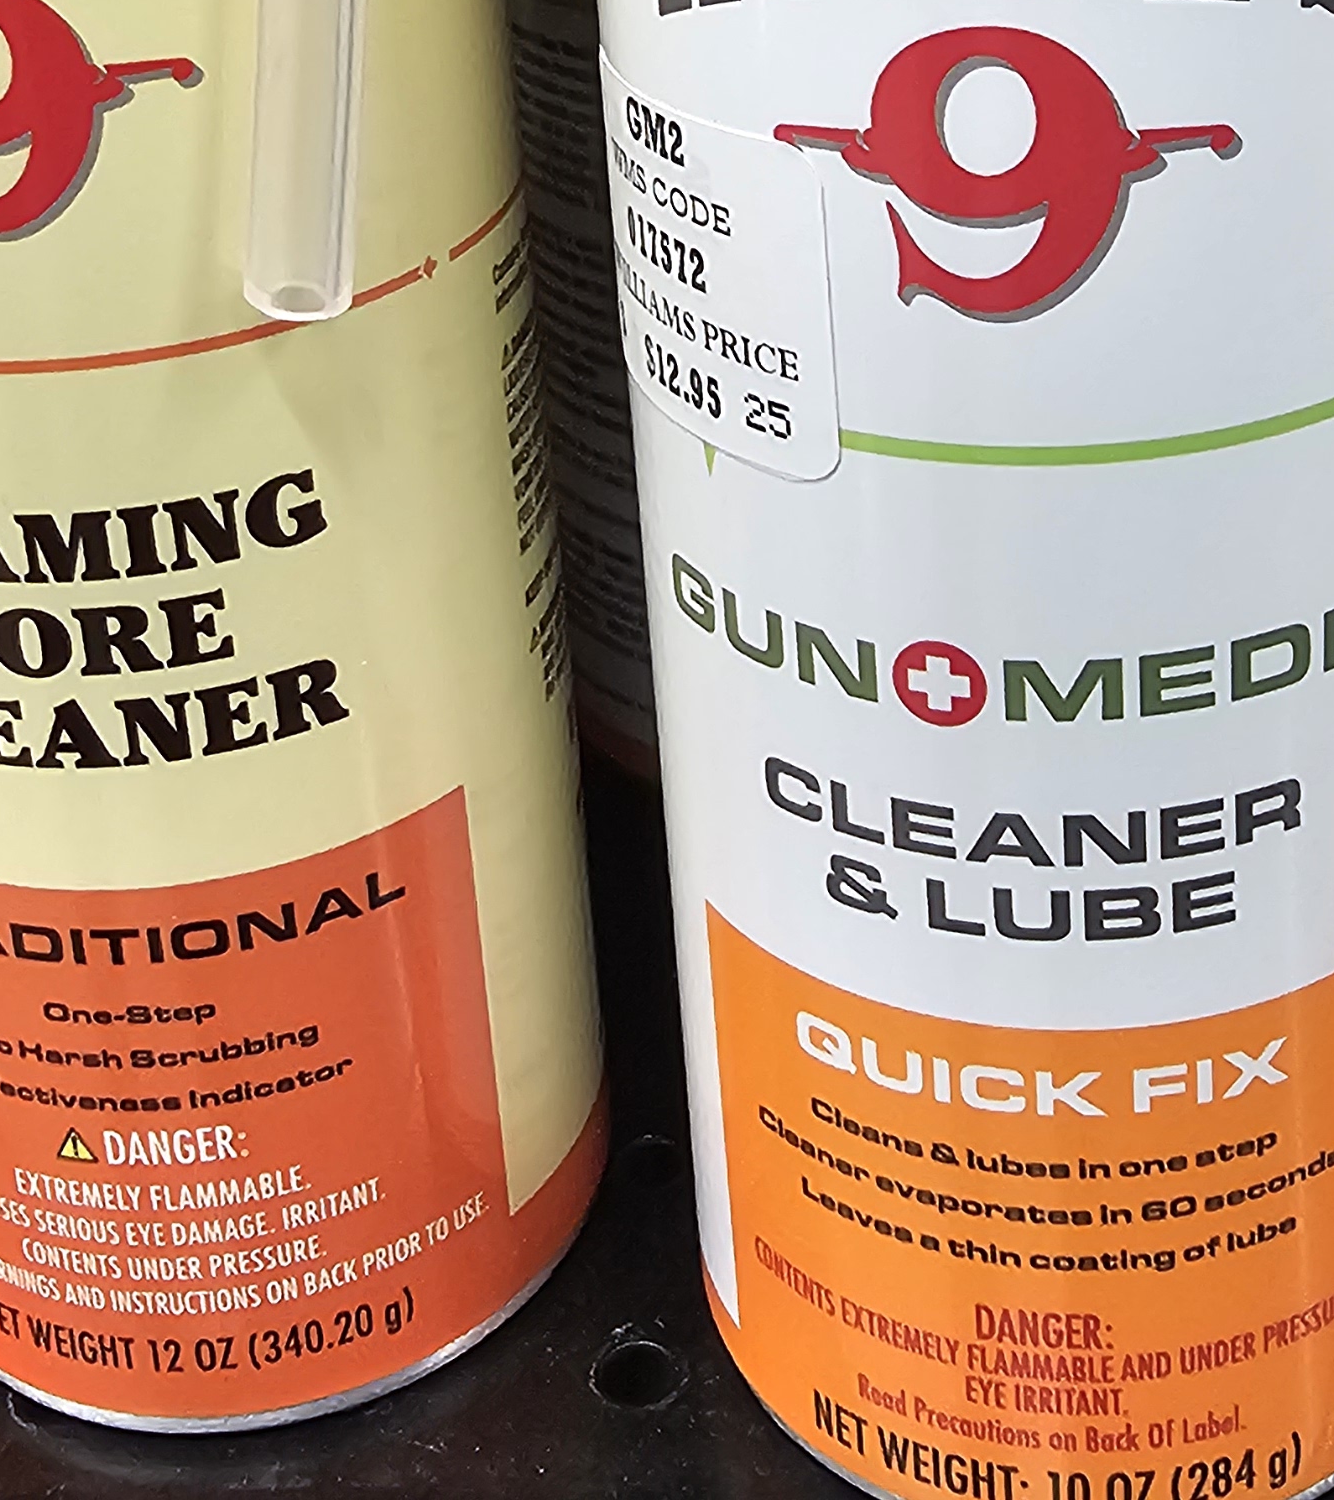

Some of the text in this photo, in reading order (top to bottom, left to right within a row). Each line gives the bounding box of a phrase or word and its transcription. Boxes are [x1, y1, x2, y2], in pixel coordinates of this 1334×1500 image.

[626, 96, 685, 168] GM2
[652, 176, 732, 237] CODE
[627, 206, 708, 294] 017572
[702, 318, 800, 382] PRICE
[644, 333, 791, 440] $12.95 25
[764, 756, 1303, 868] CLEANER
[825, 854, 1238, 942] & LUBE
[18, 1040, 123, 1070] Harsh
[130, 1025, 319, 1069] Scrubbing
[43, 1002, 216, 1025] One-Step
[189, 1058, 354, 1109] Indicator
[795, 1010, 1289, 1118] QUICK FIX
[102, 1125, 250, 1166] DANGER:
[759, 1104, 870, 1181] Cleaner
[875, 1175, 1093, 1226] evaporates
[1141, 1195, 1197, 1221] 60
[811, 1097, 1278, 1180] Cleans lubes step
[14, 1165, 312, 1212] EXTREMELY FLAMMABLE.
[34, 1208, 120, 1245] SERIOUS
[126, 1222, 166, 1247] EYE
[171, 1211, 276, 1246] DAMAGE.
[282, 1177, 387, 1231] IRRITANT.
[801, 1175, 1297, 1272] Leaves thin coating lube
[21, 1234, 328, 1281] CONTENTS UNDER PRESSURE.
[65, 1232, 423, 1316] AND INSTRUCTIONS ON BACK PRIOR
[27, 1314, 135, 1370] WEIGHT
[146, 1338, 185, 1373] 12
[194, 1336, 238, 1373] OZ
[248, 1303, 373, 1371] (340.20
[754, 1234, 1257, 1384] CONTENTS EXTREMELY FLAMMABLE AND UNDER
[975, 1303, 1115, 1351] DANGER:
[857, 1372, 1140, 1453] Read Precautions Back
[965, 1375, 1130, 1417] EYE IRRITANT.
[813, 1388, 1030, 1500] NET WEIGHT:
